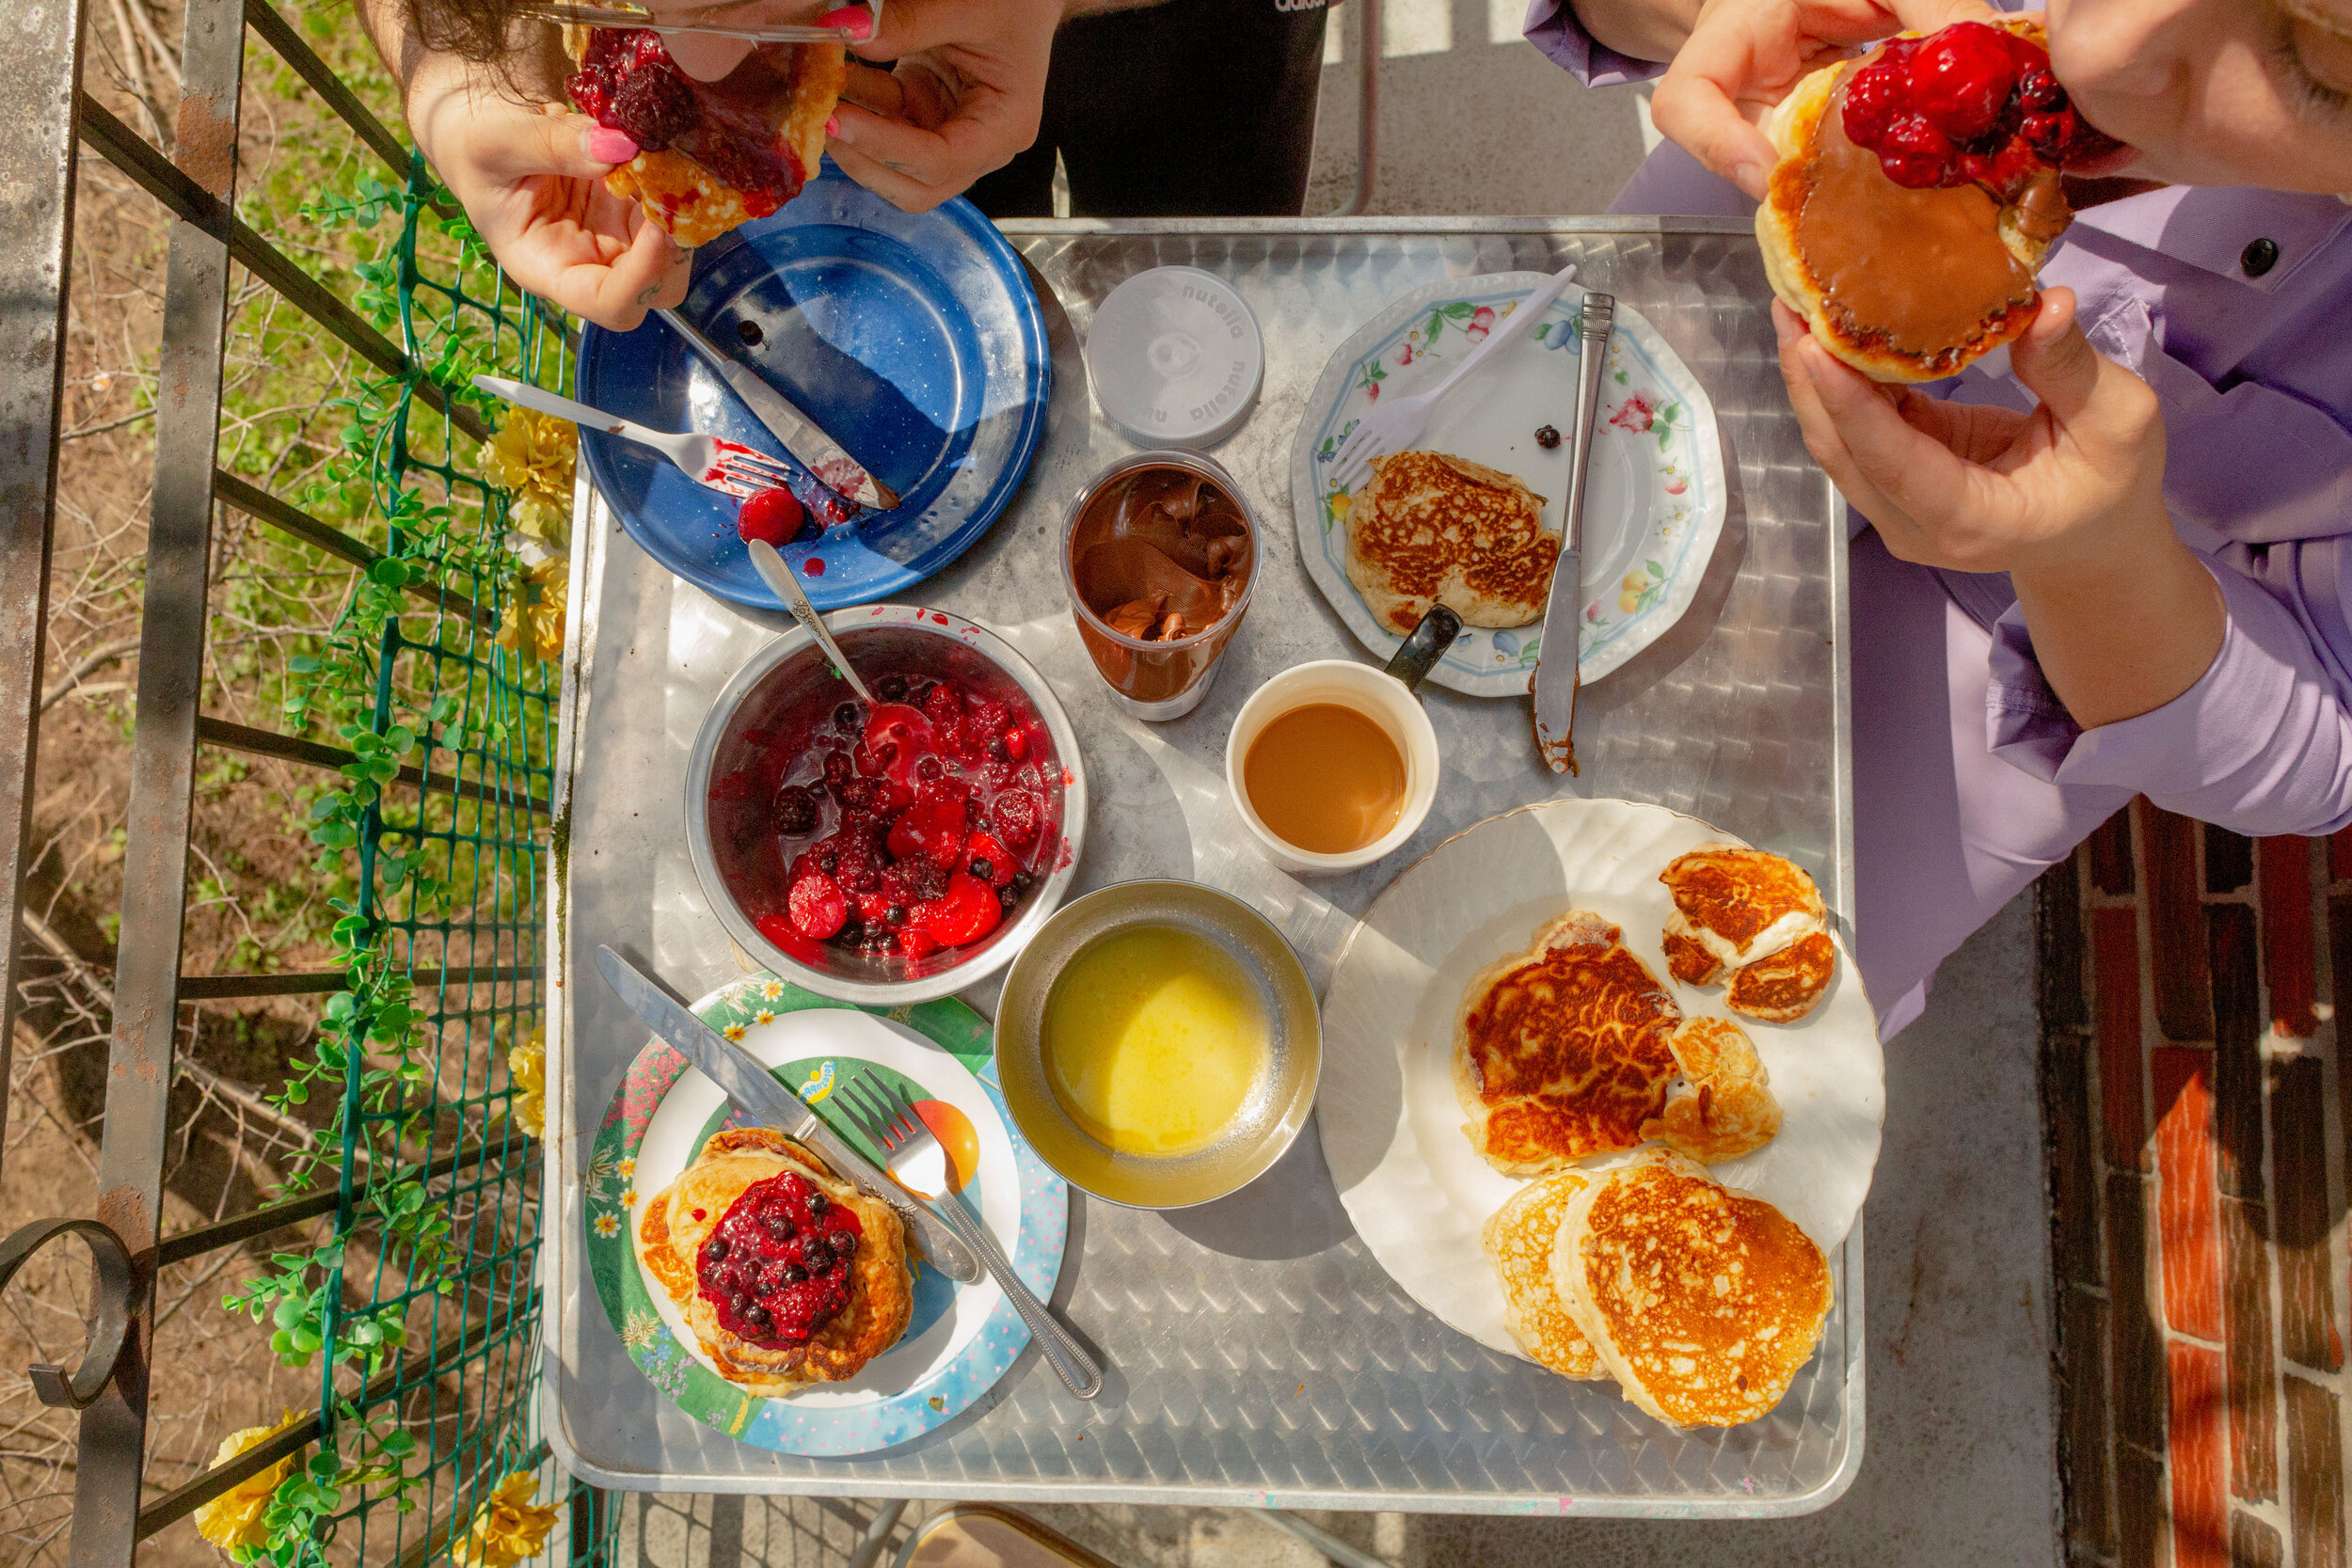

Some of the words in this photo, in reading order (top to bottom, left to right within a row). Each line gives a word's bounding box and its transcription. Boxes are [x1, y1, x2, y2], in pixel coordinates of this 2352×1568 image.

[1183, 285, 1245, 339] nutella
[1189, 360, 1246, 421] nutella
[800, 1061, 835, 1104] Teletubbi
